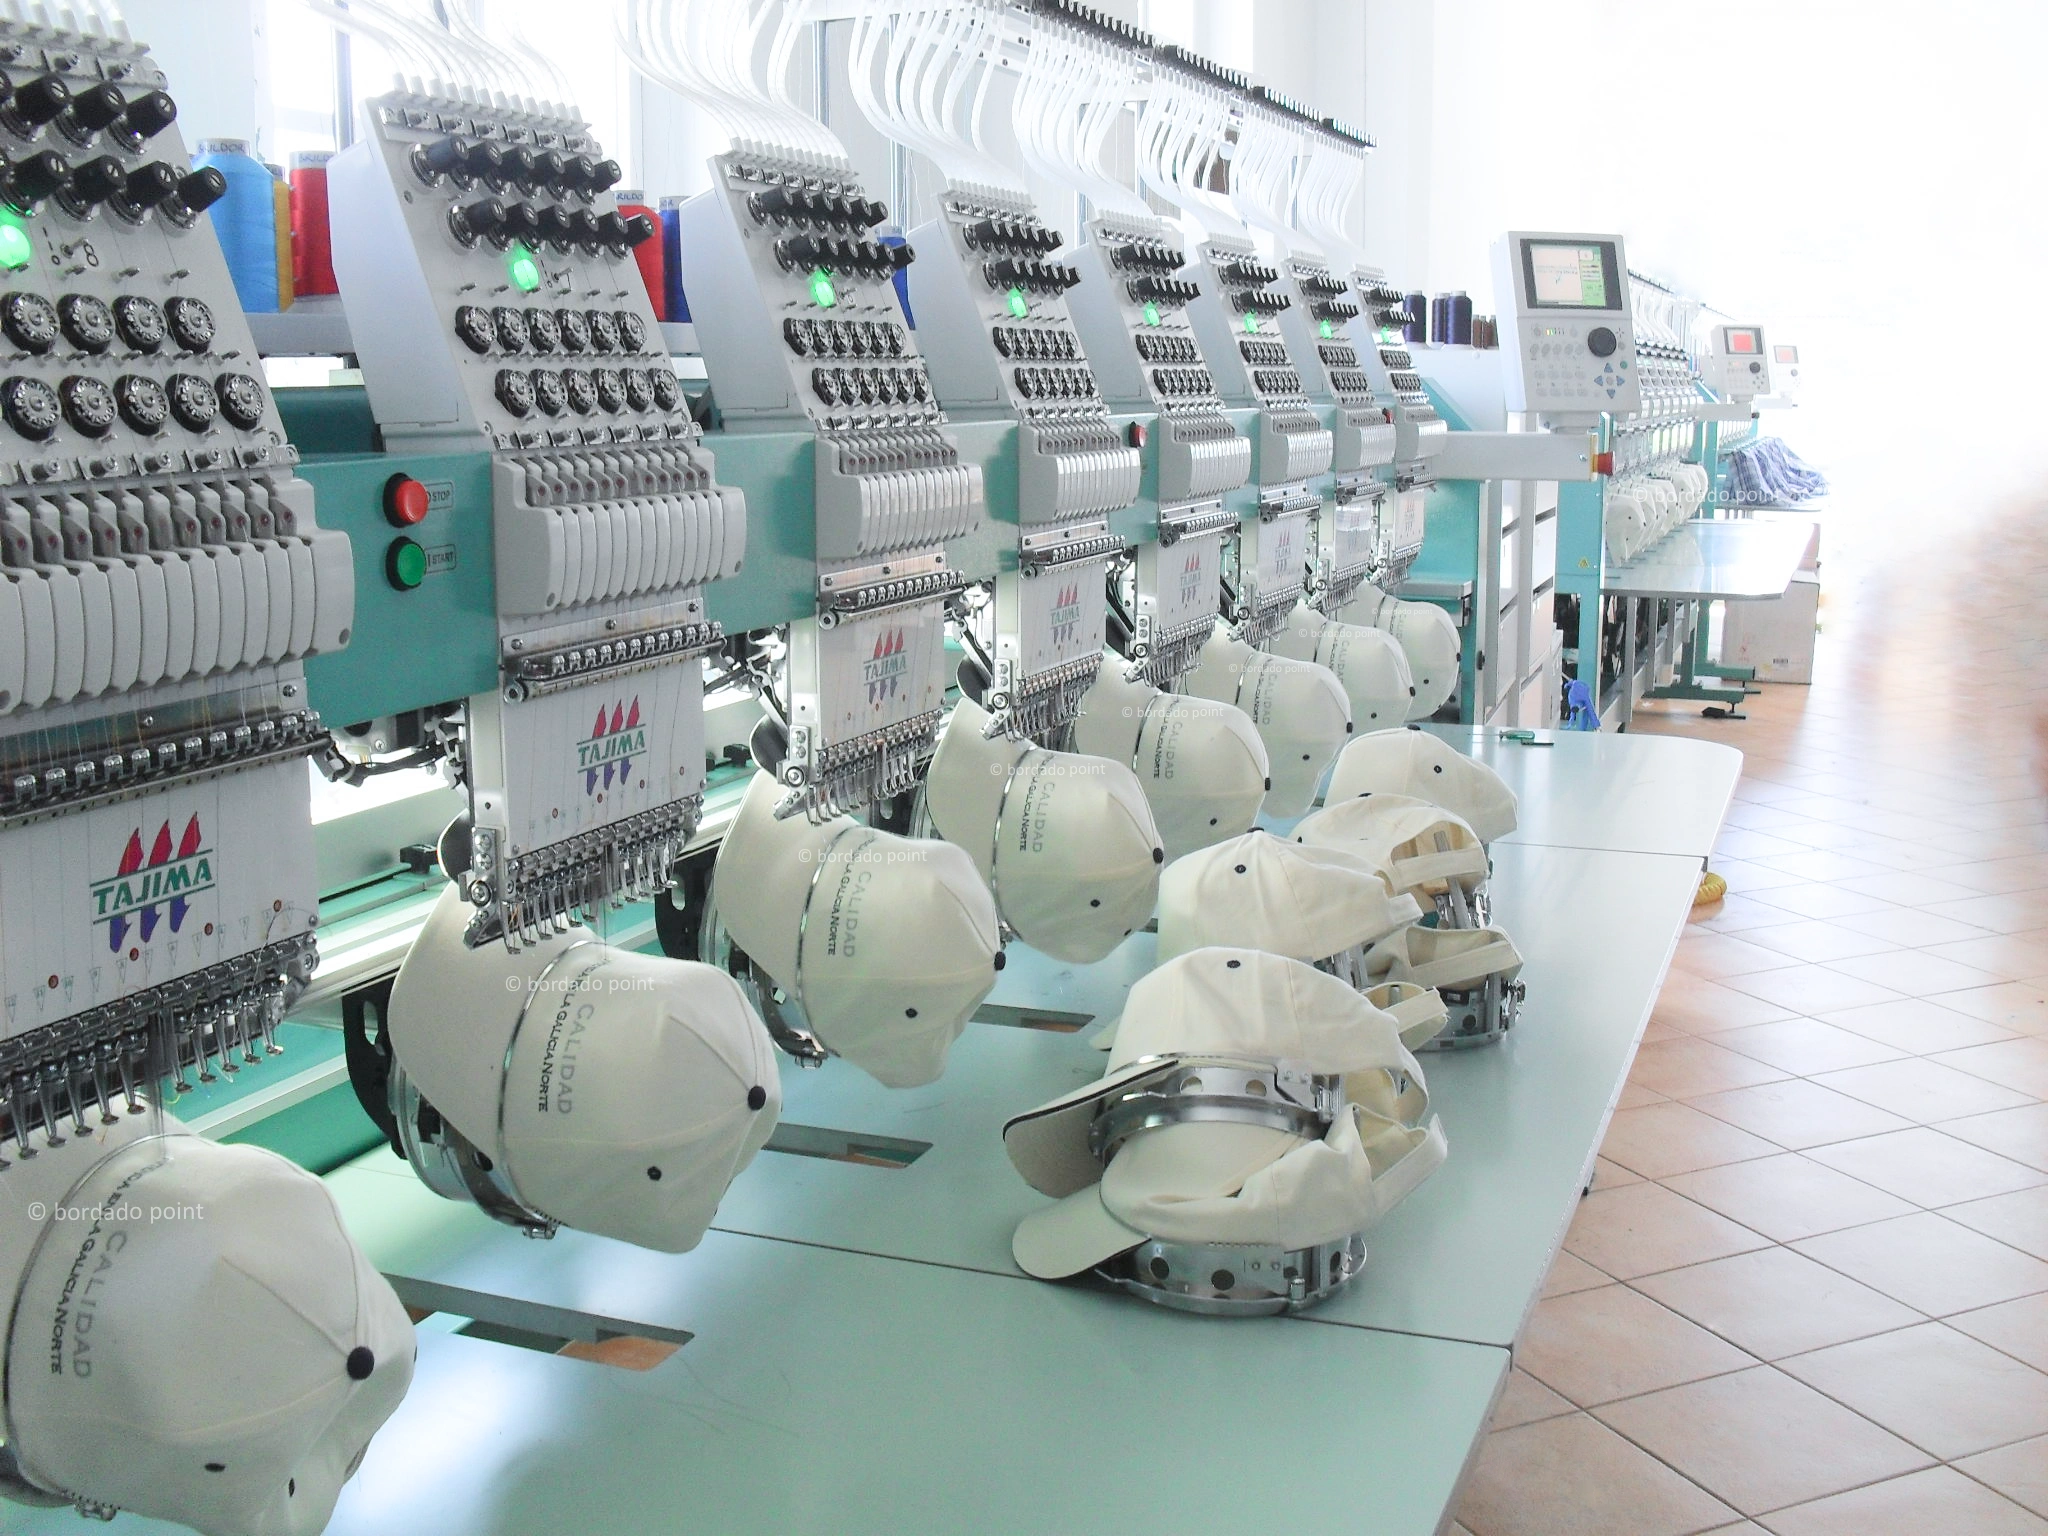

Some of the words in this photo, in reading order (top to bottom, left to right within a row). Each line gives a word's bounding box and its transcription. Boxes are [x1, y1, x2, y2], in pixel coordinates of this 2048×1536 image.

[198, 143, 245, 153] BILDOR
[84, 243, 99, 267] 8
[432, 490, 450, 502] STOP
[432, 552, 453, 565] START
[864, 655, 906, 681] TAJIMA
[577, 730, 646, 767] TAJIMA
[1164, 721, 1183, 780] CALIDAD
[1019, 819, 1030, 852] NORTE
[1032, 782, 1055, 853] CALIDAD
[93, 858, 214, 915] TAJIMA
[827, 915, 840, 956] NORTE
[843, 871, 872, 958] CALIDAD
[543, 1010, 567, 1063] GALICIA
[557, 1003, 595, 1115] CALIDAD
[538, 1062, 554, 1112] NORTE
[58, 1238, 96, 1306] GALICIA
[73, 1230, 128, 1380] CALIDAD
[50, 1307, 69, 1376] NORTE
